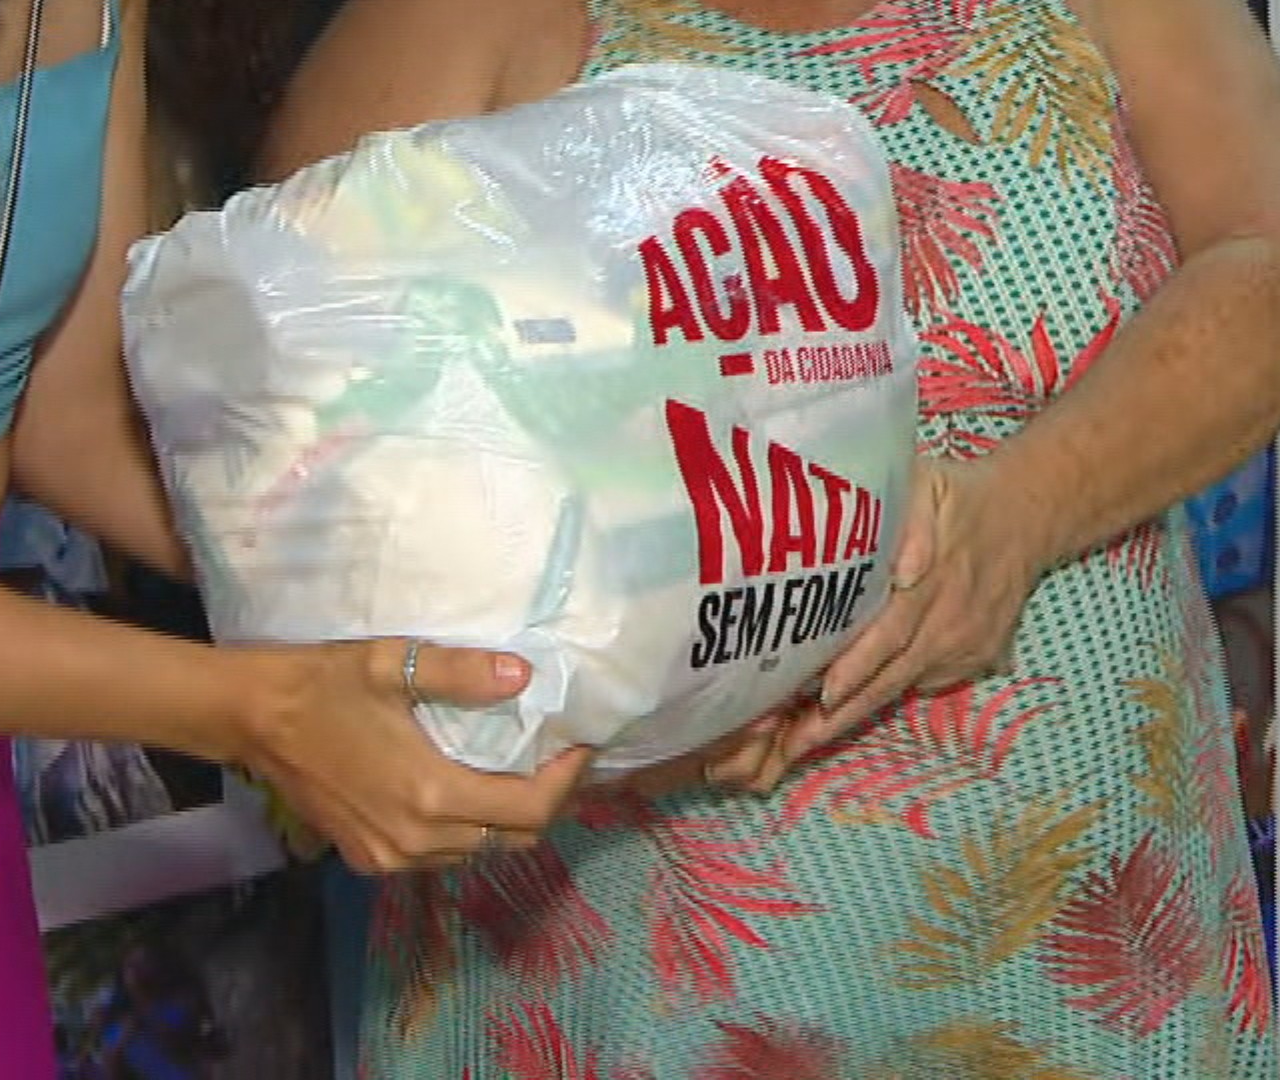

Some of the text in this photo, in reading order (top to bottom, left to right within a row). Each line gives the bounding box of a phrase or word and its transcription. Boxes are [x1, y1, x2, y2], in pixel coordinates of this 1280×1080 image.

[763, 340, 894, 385] DA CIDADANIA
[665, 398, 882, 585] NATAL
[690, 562, 876, 669] SEM FOME
